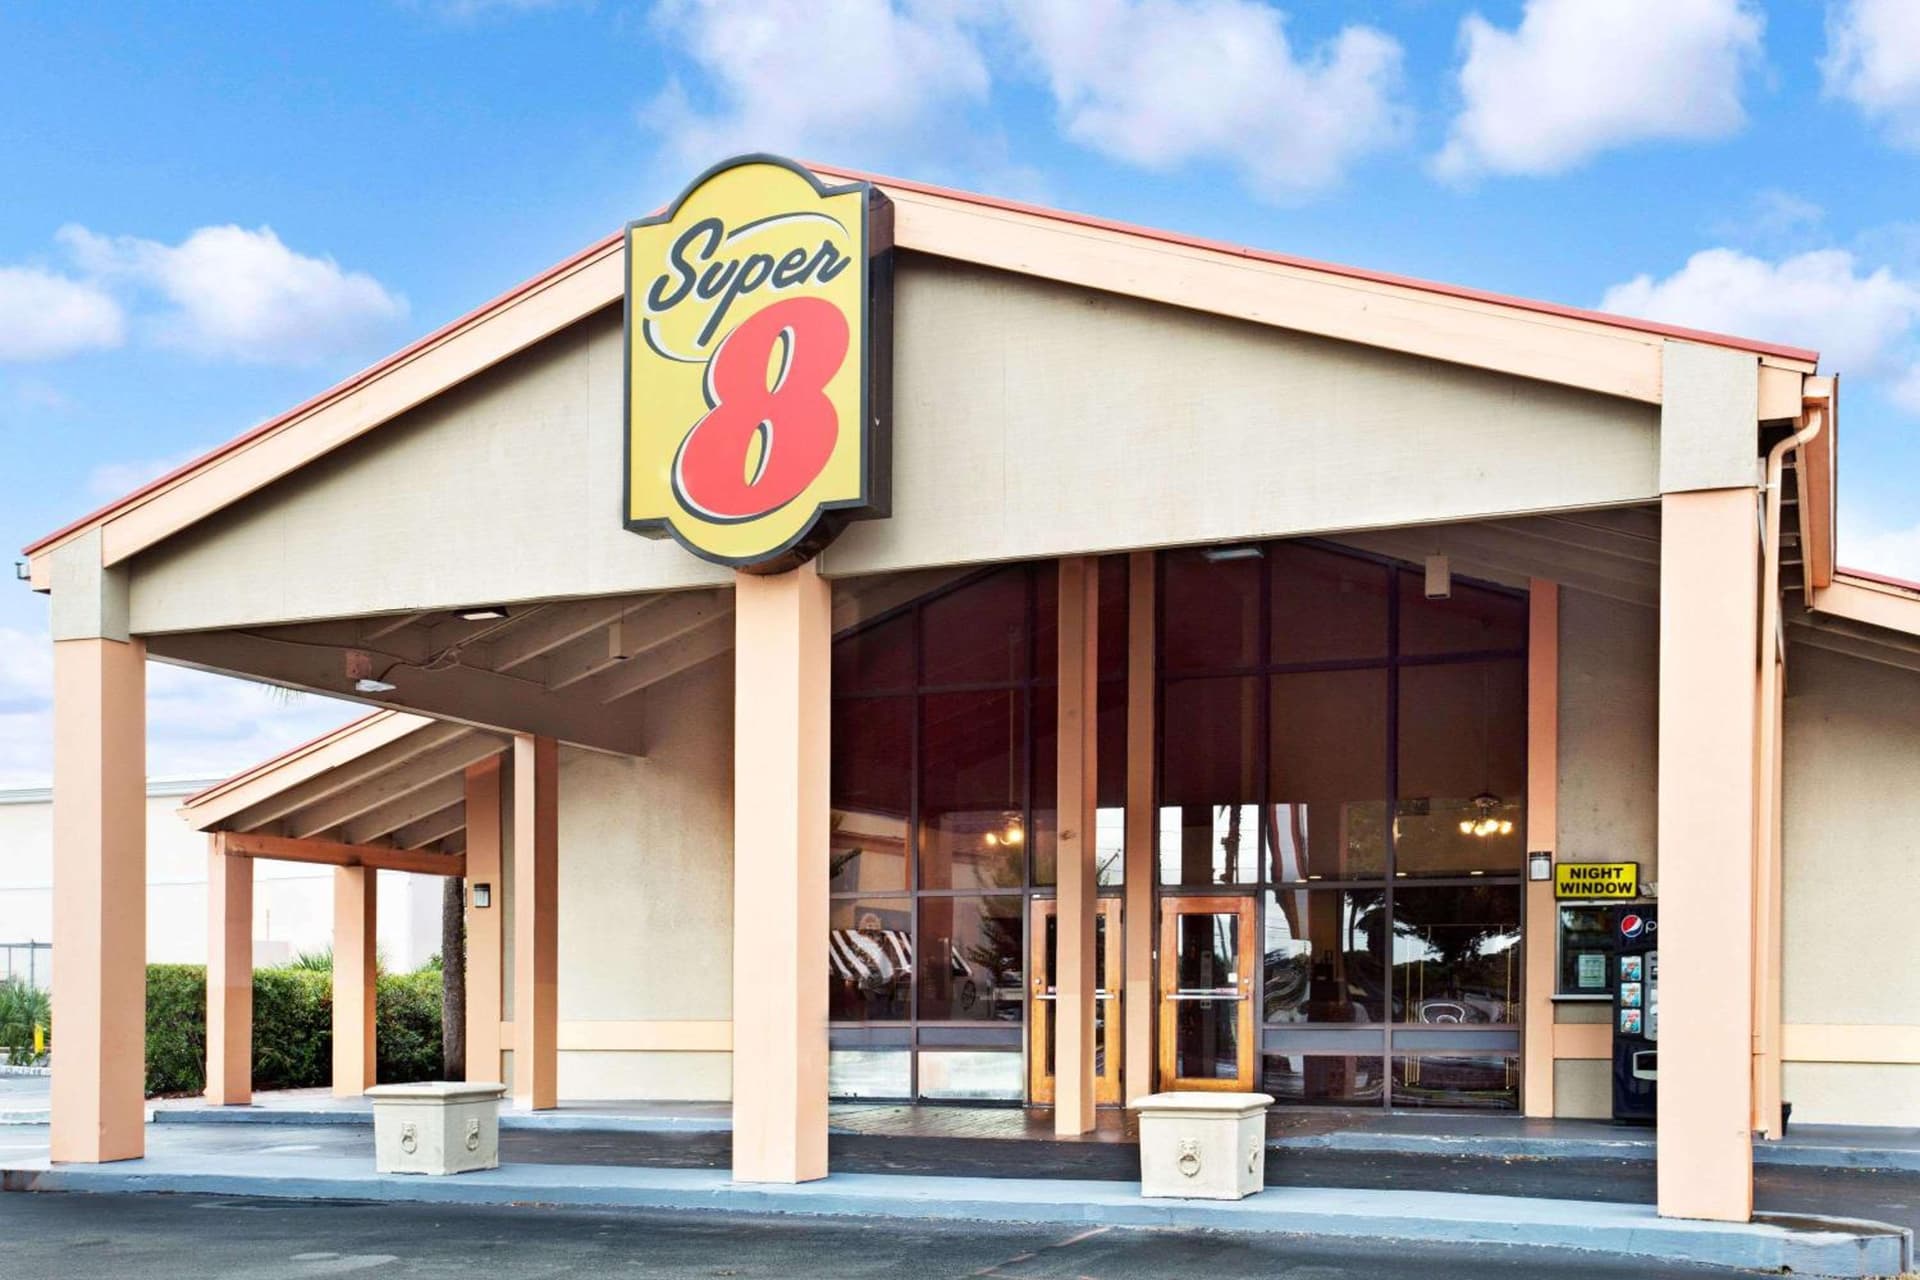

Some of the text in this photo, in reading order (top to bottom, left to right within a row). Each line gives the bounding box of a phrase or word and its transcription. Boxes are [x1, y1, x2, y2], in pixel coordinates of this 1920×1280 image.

[648, 217, 851, 347] Super
[672, 296, 849, 524] 8
[1561, 883, 1632, 894] WINDOW
[1570, 868, 1623, 879] NIGHT
